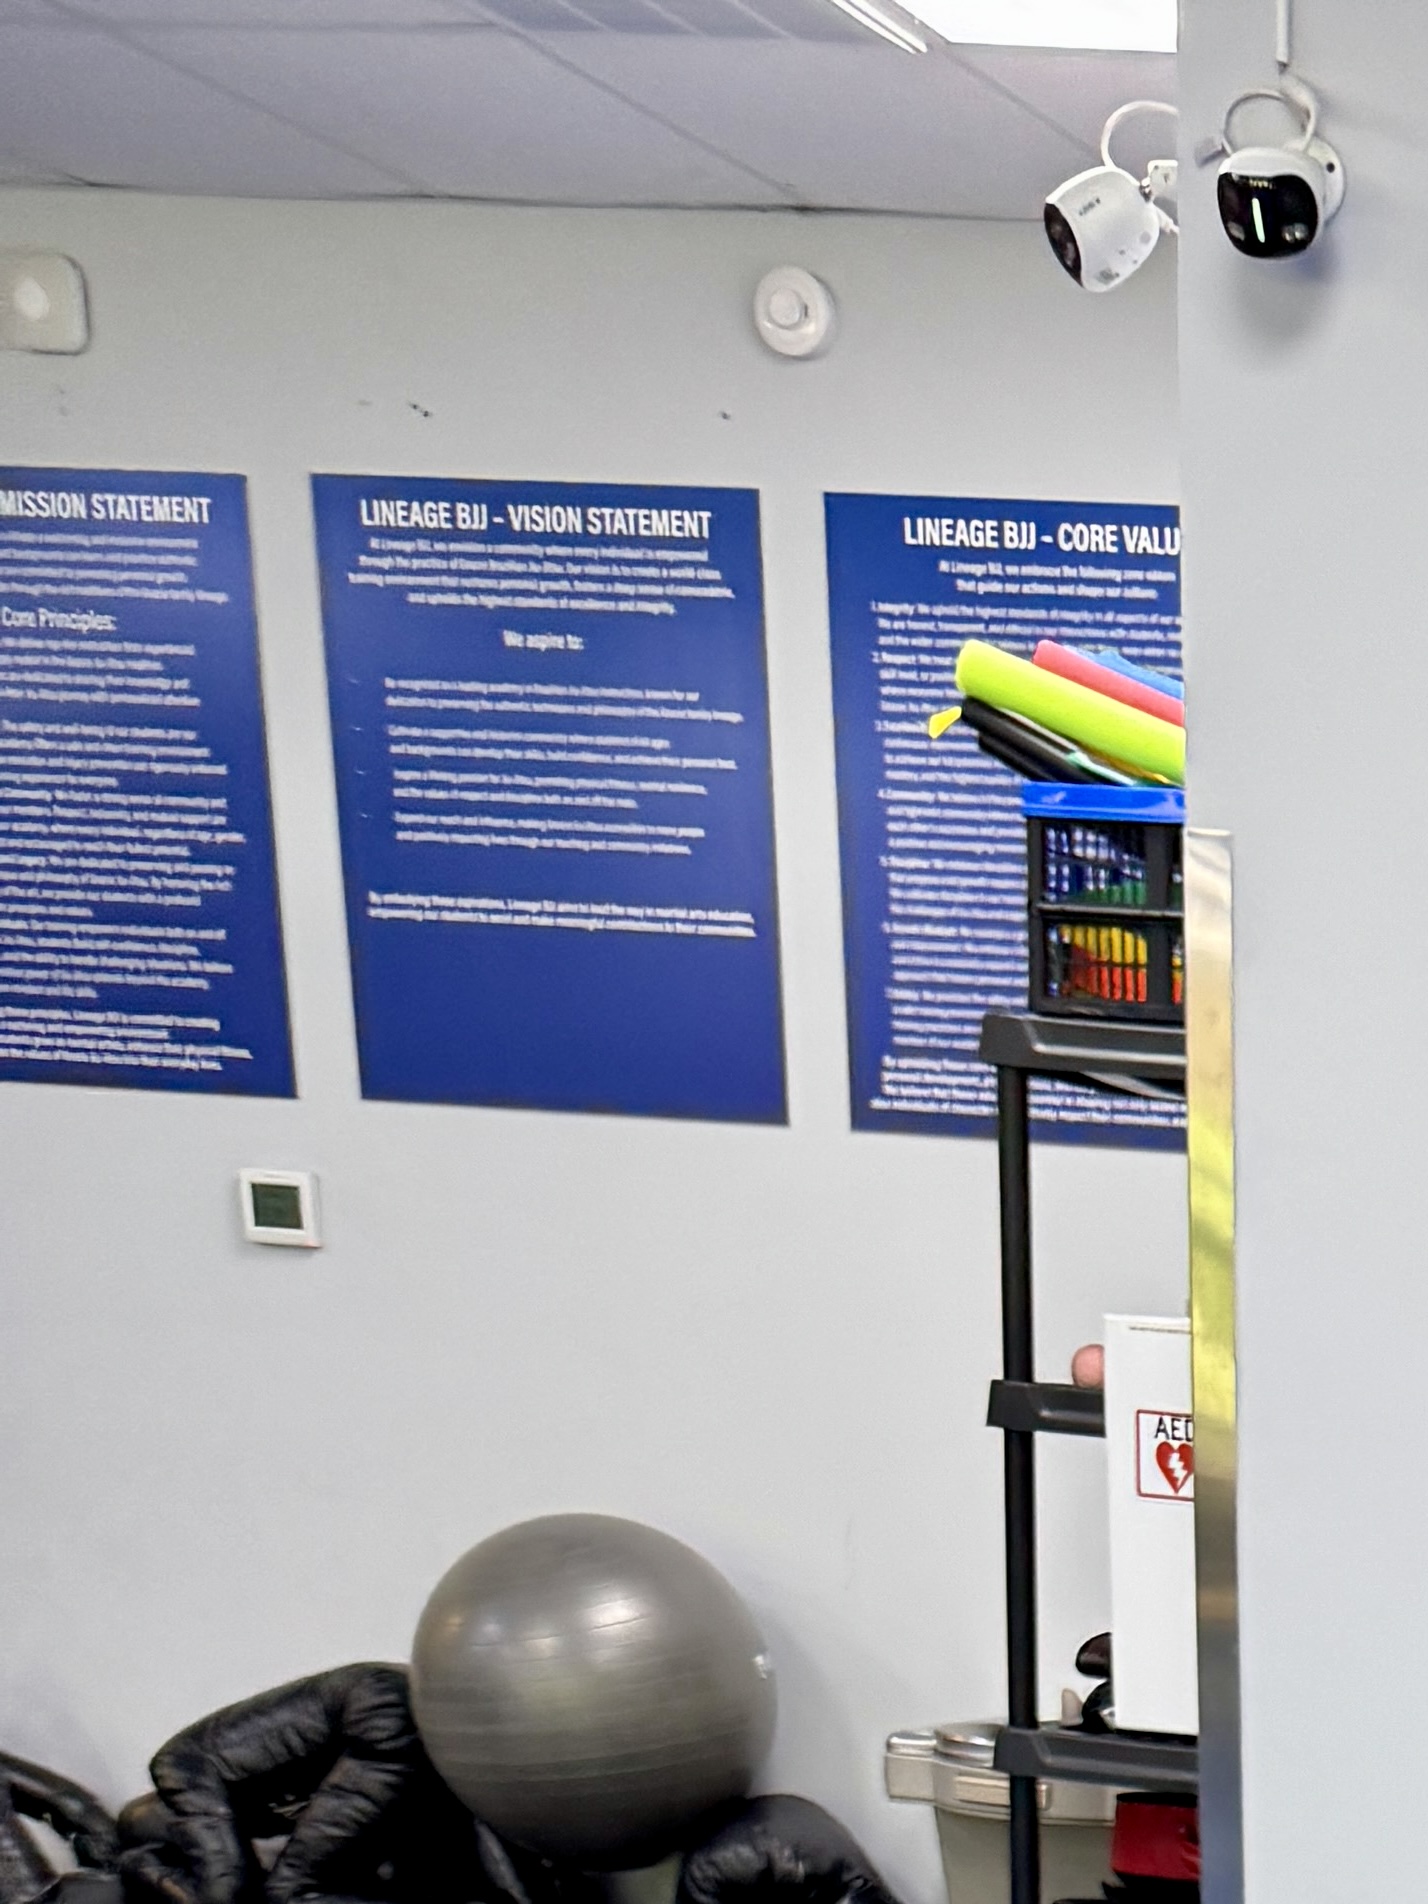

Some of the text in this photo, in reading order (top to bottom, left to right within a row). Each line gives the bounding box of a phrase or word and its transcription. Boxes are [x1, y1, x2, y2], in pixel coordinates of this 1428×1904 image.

[0, 490, 212, 523] MISSION STATEMENT
[360, 499, 453, 529] LINEAGE
[456, 503, 487, 530] BJJ
[507, 505, 583, 533] VISION
[586, 508, 712, 539] STATEMENT
[903, 517, 999, 548] LINEAGE
[1003, 520, 1036, 549] BJJ
[1058, 523, 1118, 553] CORE
